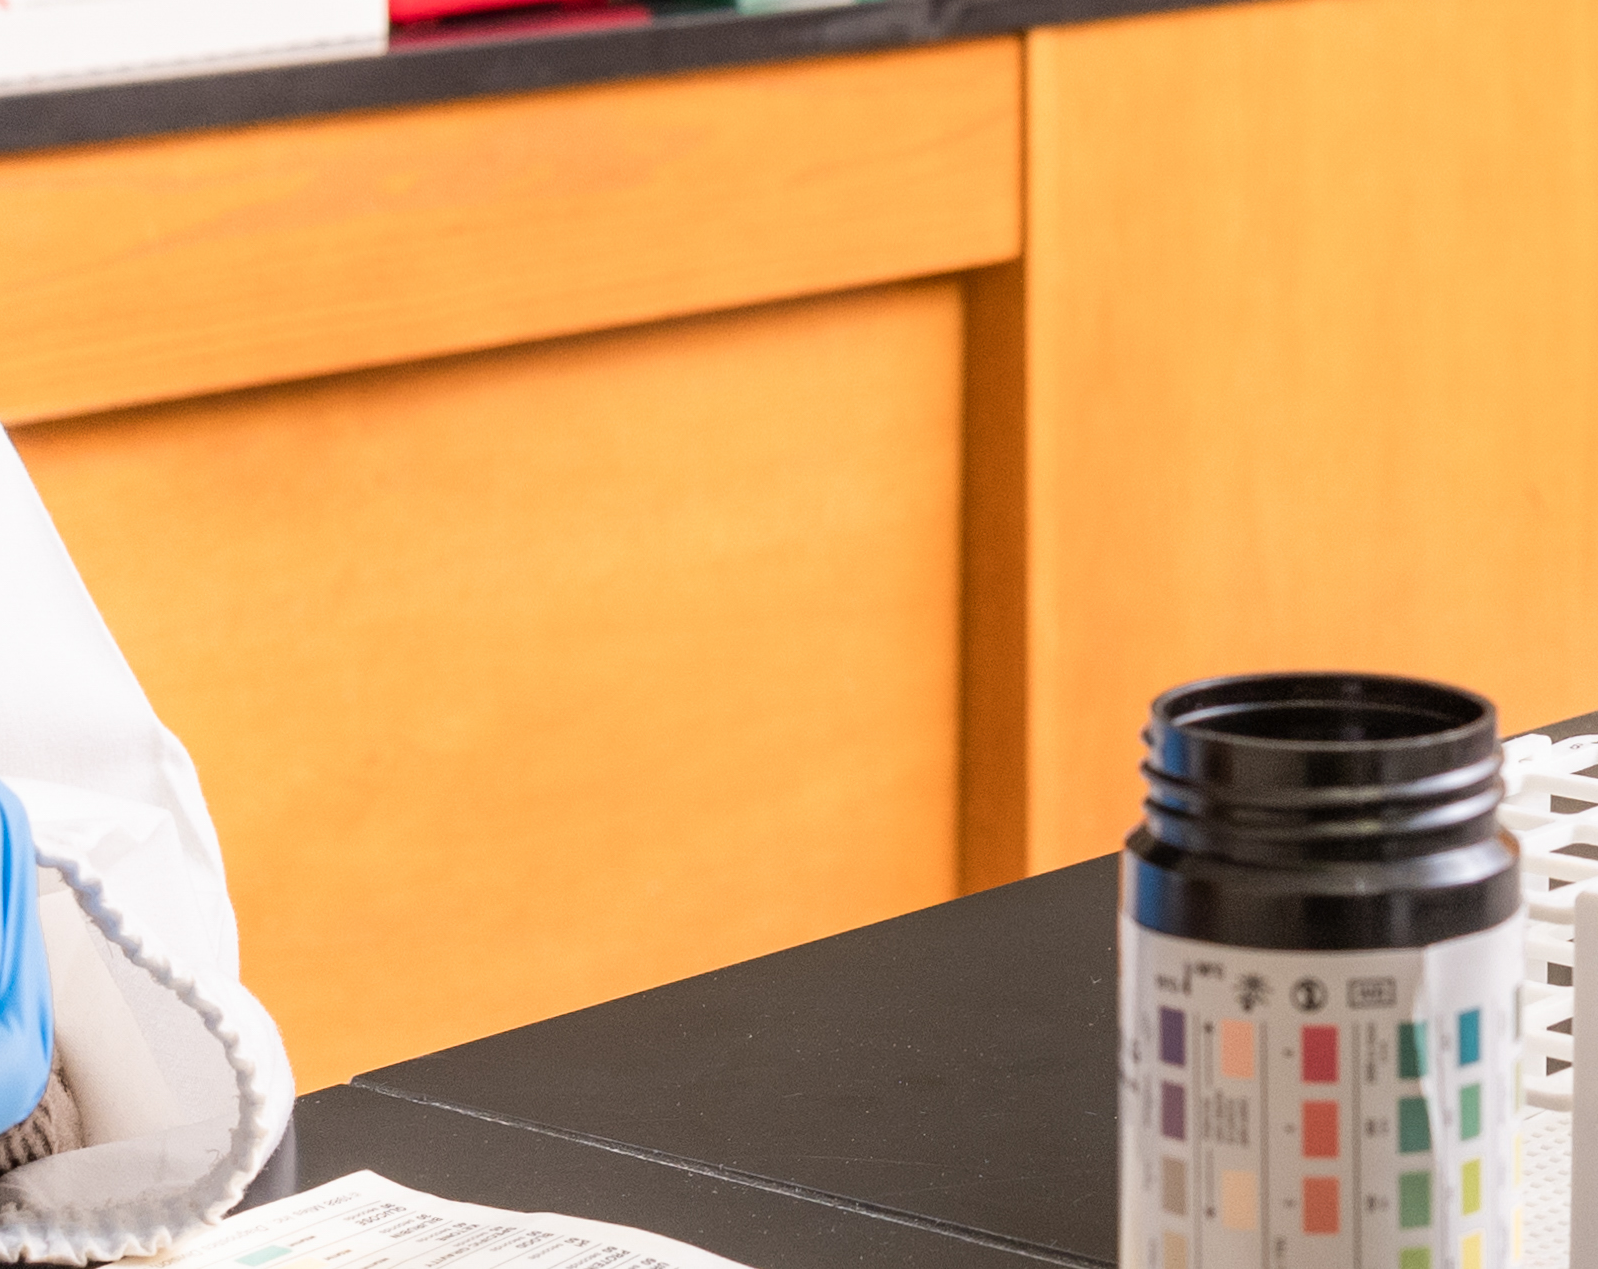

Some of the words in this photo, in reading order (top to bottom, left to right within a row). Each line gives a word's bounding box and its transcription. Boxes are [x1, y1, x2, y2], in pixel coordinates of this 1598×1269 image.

[355, 1206, 407, 1226] GLUCOSE
[390, 1217, 444, 1239] BILIRUBIN
[435, 1223, 481, 1242] KETONE
[515, 1233, 555, 1249] BLOOD
